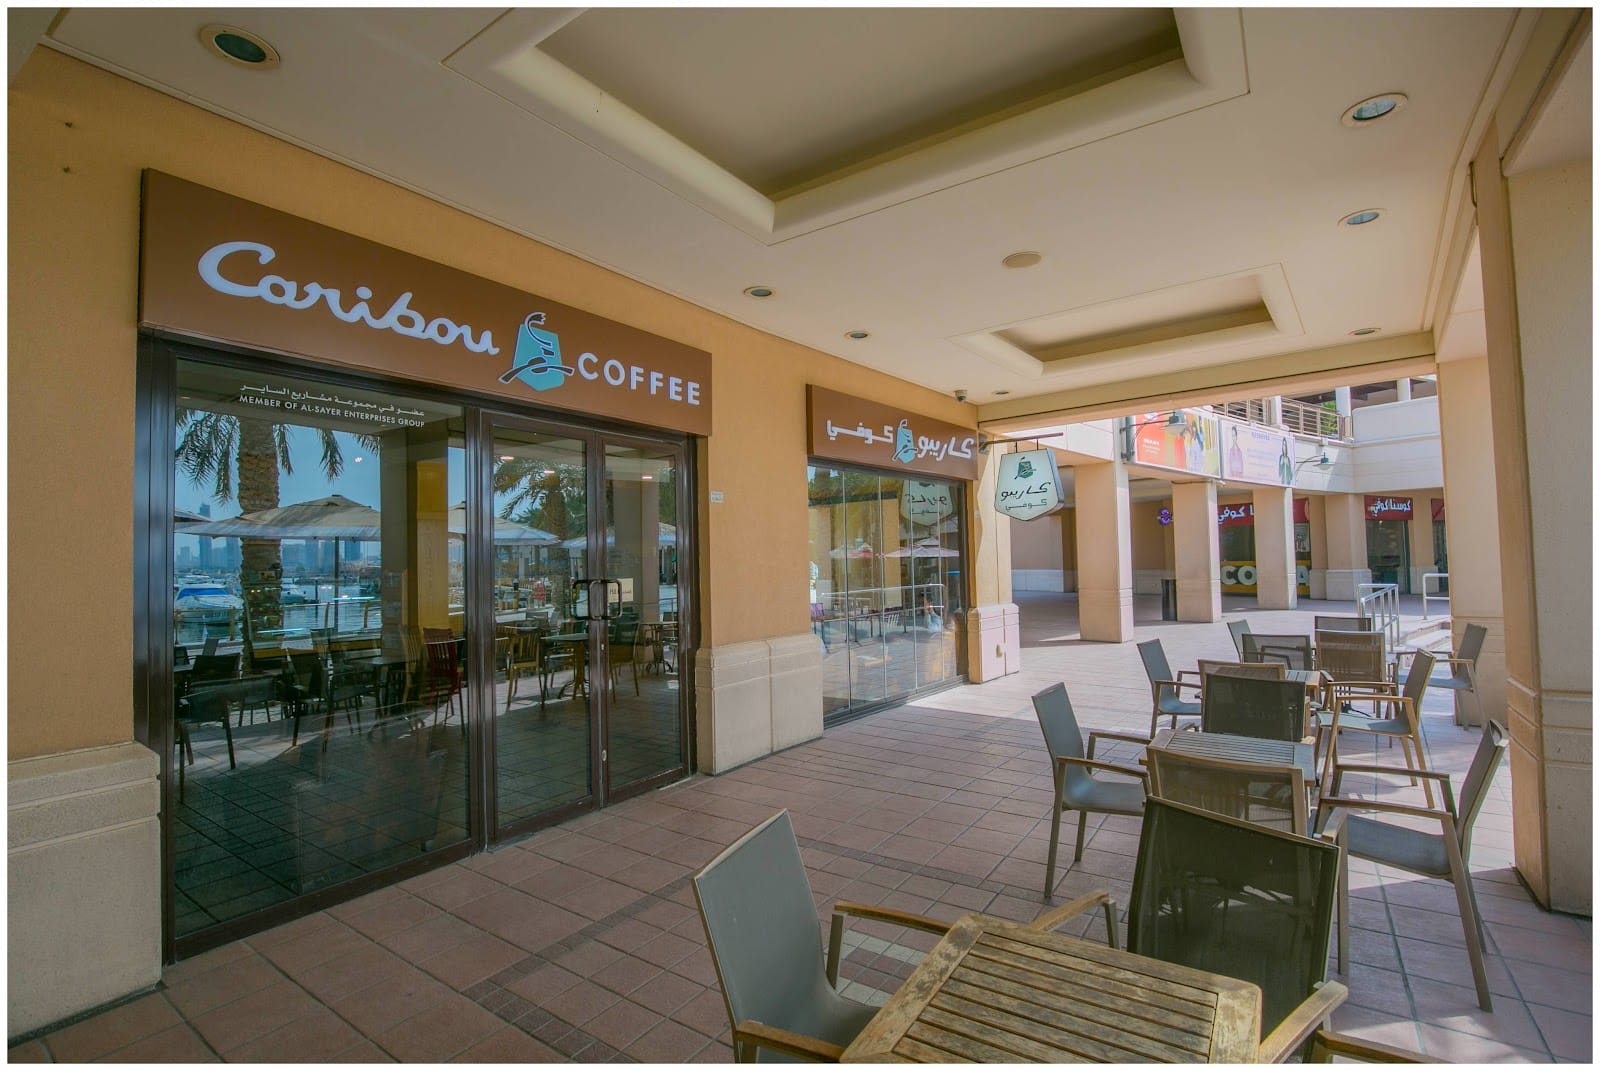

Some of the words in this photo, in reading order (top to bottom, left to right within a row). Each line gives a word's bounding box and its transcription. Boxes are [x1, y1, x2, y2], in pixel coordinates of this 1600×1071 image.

[198, 240, 500, 356] Caribou
[577, 352, 701, 406] COFFEE
[239, 384, 290, 395] الساير
[291, 391, 333, 402] مشاريع
[334, 395, 377, 410] مجموعة
[378, 404, 395, 413] في
[239, 394, 281, 408] MEMBER
[284, 401, 298, 410] OF
[300, 404, 342, 416] AL-SAYER
[344, 410, 396, 424] ENTERPRISES
[397, 418, 425, 428] GROUP
[396, 408, 425, 417] عضو
[826, 419, 894, 445] كوفي
[917, 435, 975, 461] كاريبو
[1000, 481, 1052, 502] كاريبو
[1005, 498, 1048, 512] كوفي
